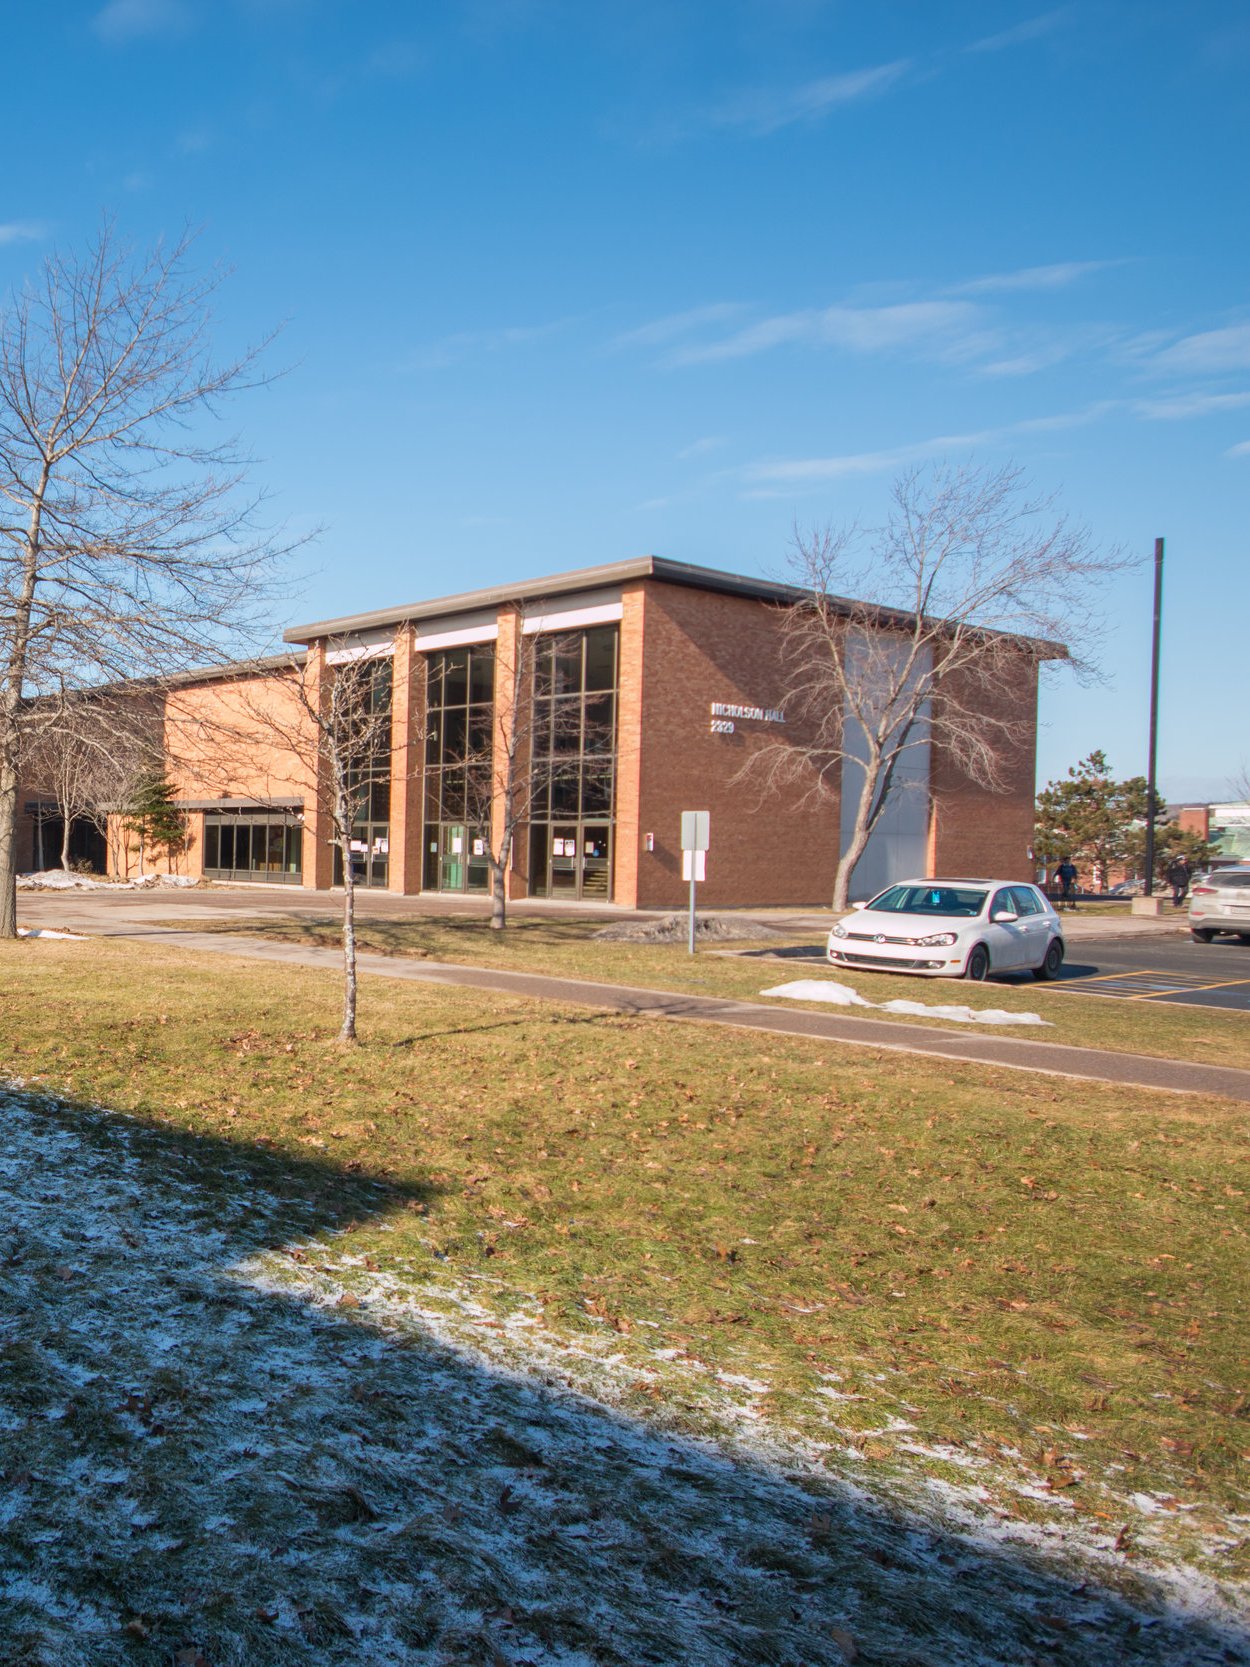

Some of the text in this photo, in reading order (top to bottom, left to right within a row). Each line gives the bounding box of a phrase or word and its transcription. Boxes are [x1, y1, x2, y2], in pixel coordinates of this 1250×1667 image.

[711, 702, 786, 722] NICHOLSON HALL
[710, 720, 734, 734] 2329
